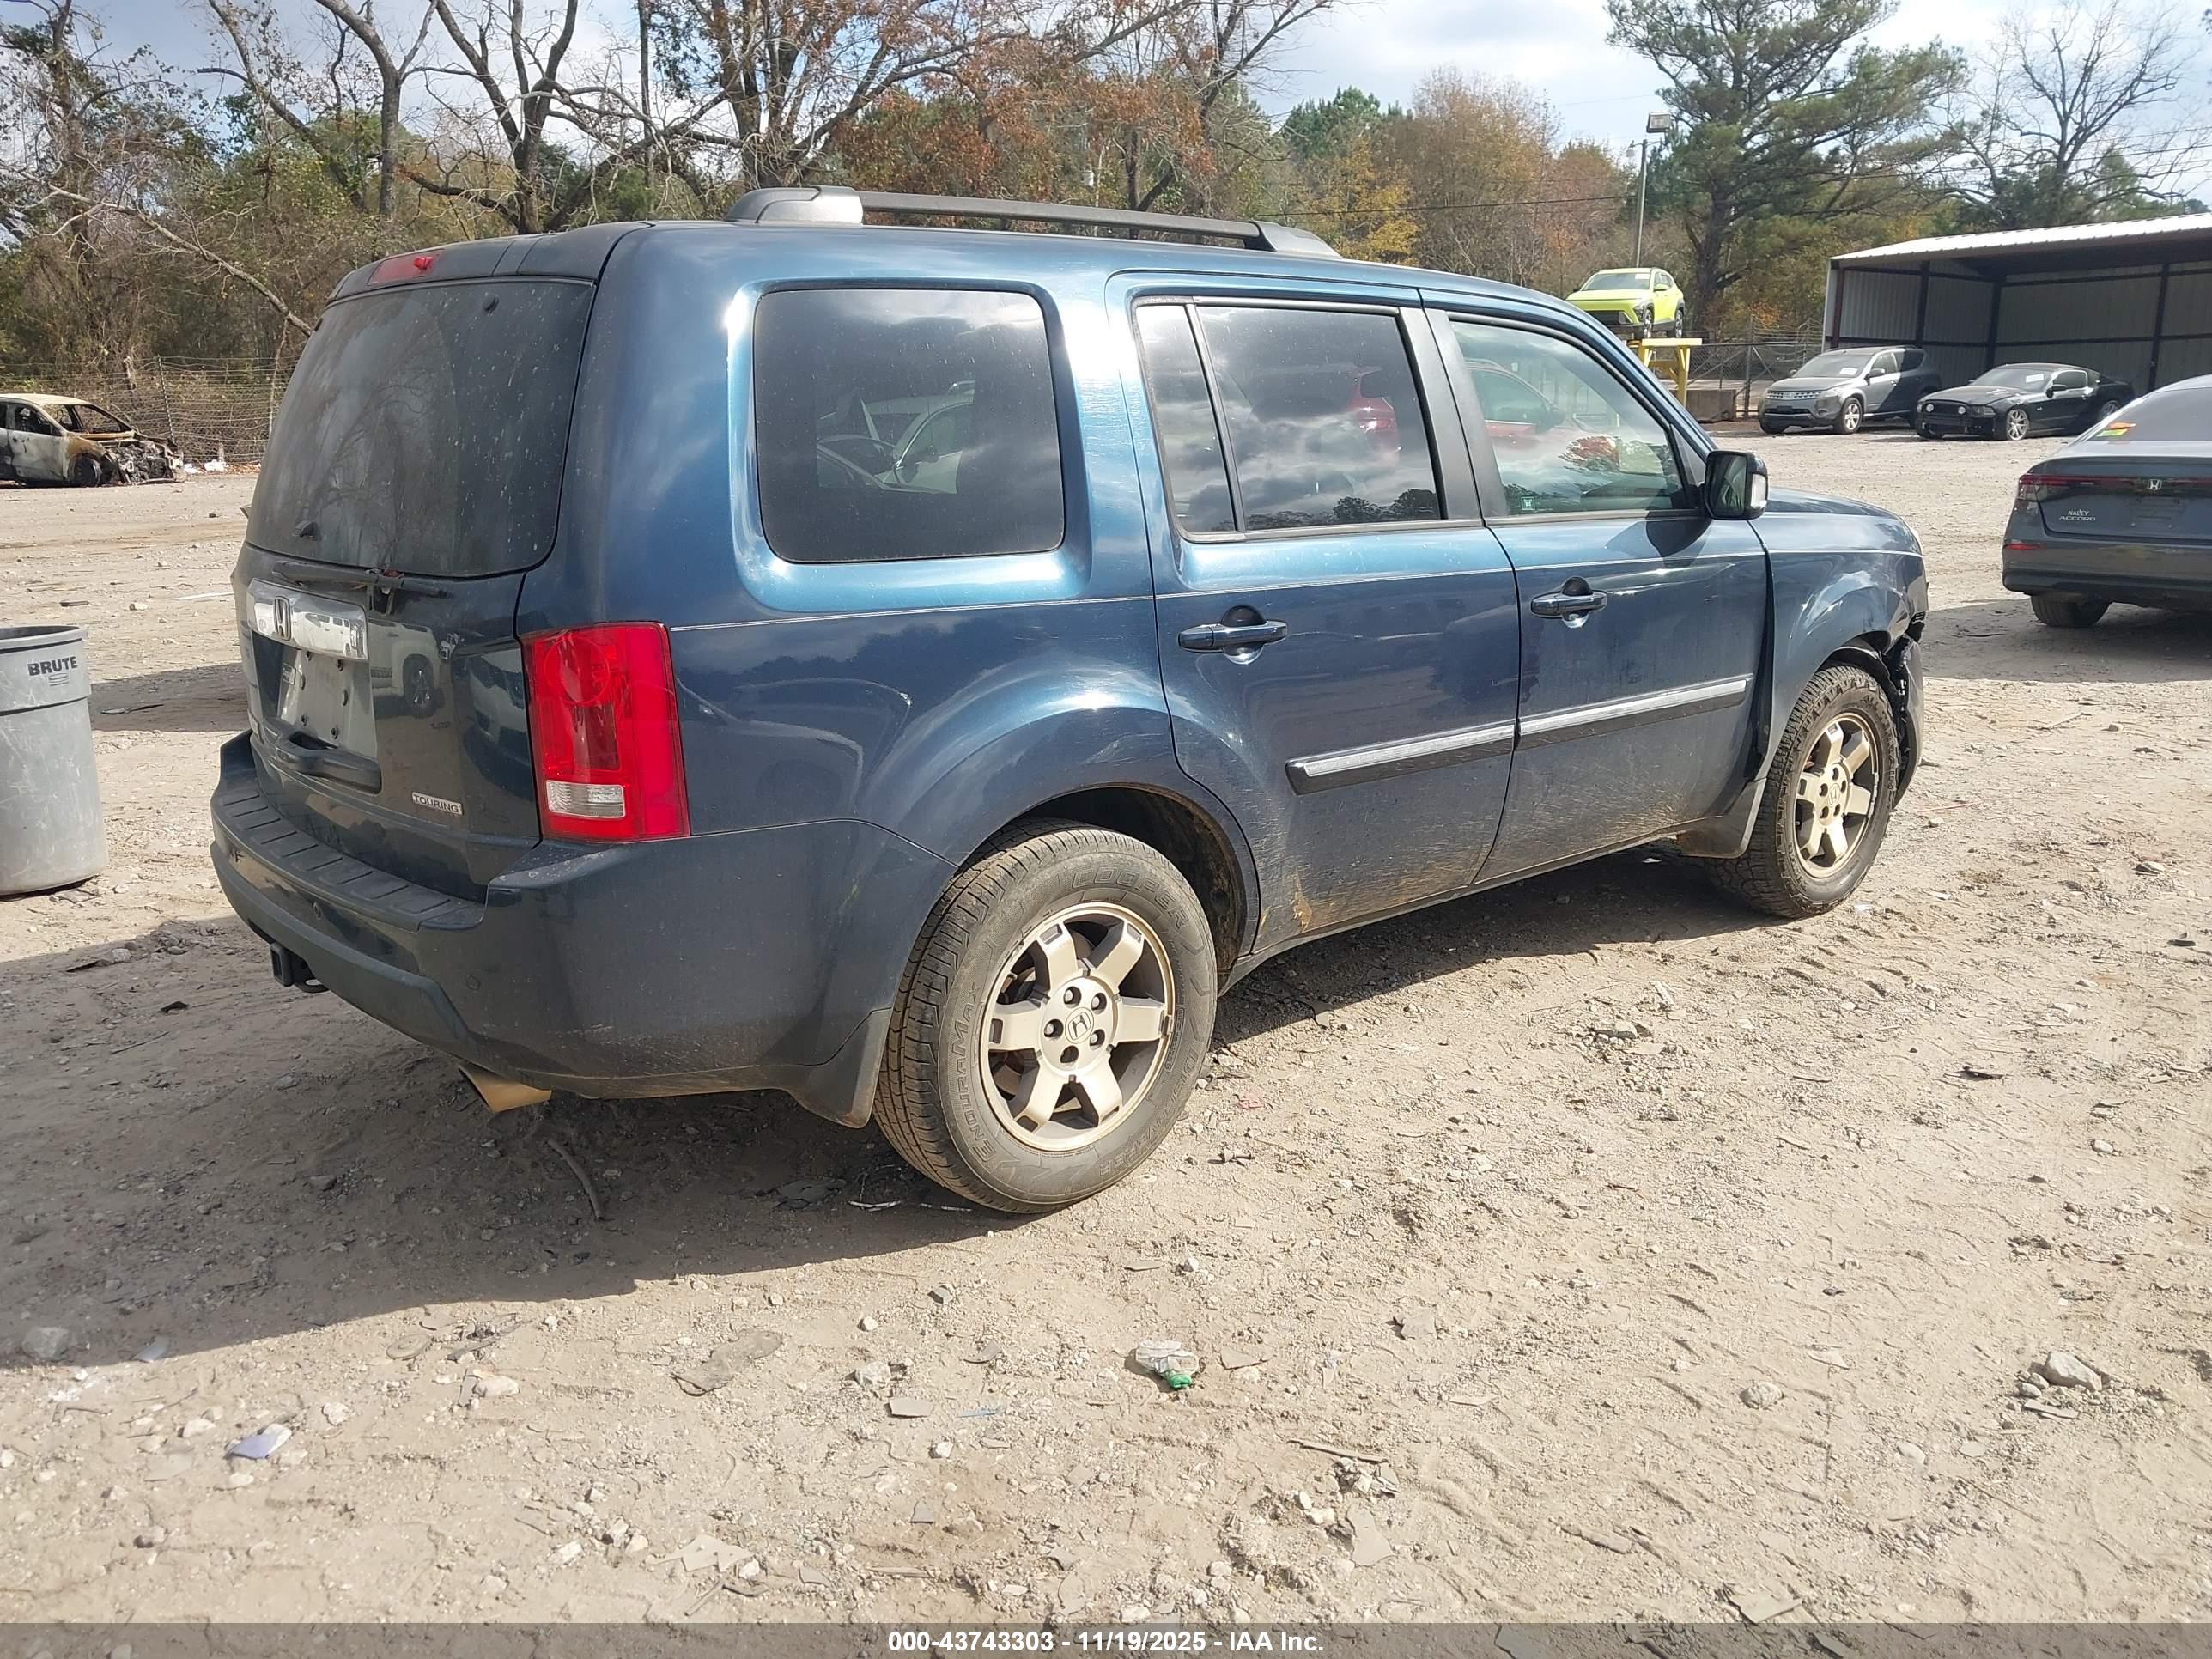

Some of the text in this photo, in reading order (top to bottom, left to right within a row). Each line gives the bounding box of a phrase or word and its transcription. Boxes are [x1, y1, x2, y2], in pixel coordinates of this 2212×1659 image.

[27, 655, 78, 677] BRUTE
[412, 793, 460, 813] TOURING
[1072, 866, 1189, 930] COOPER
